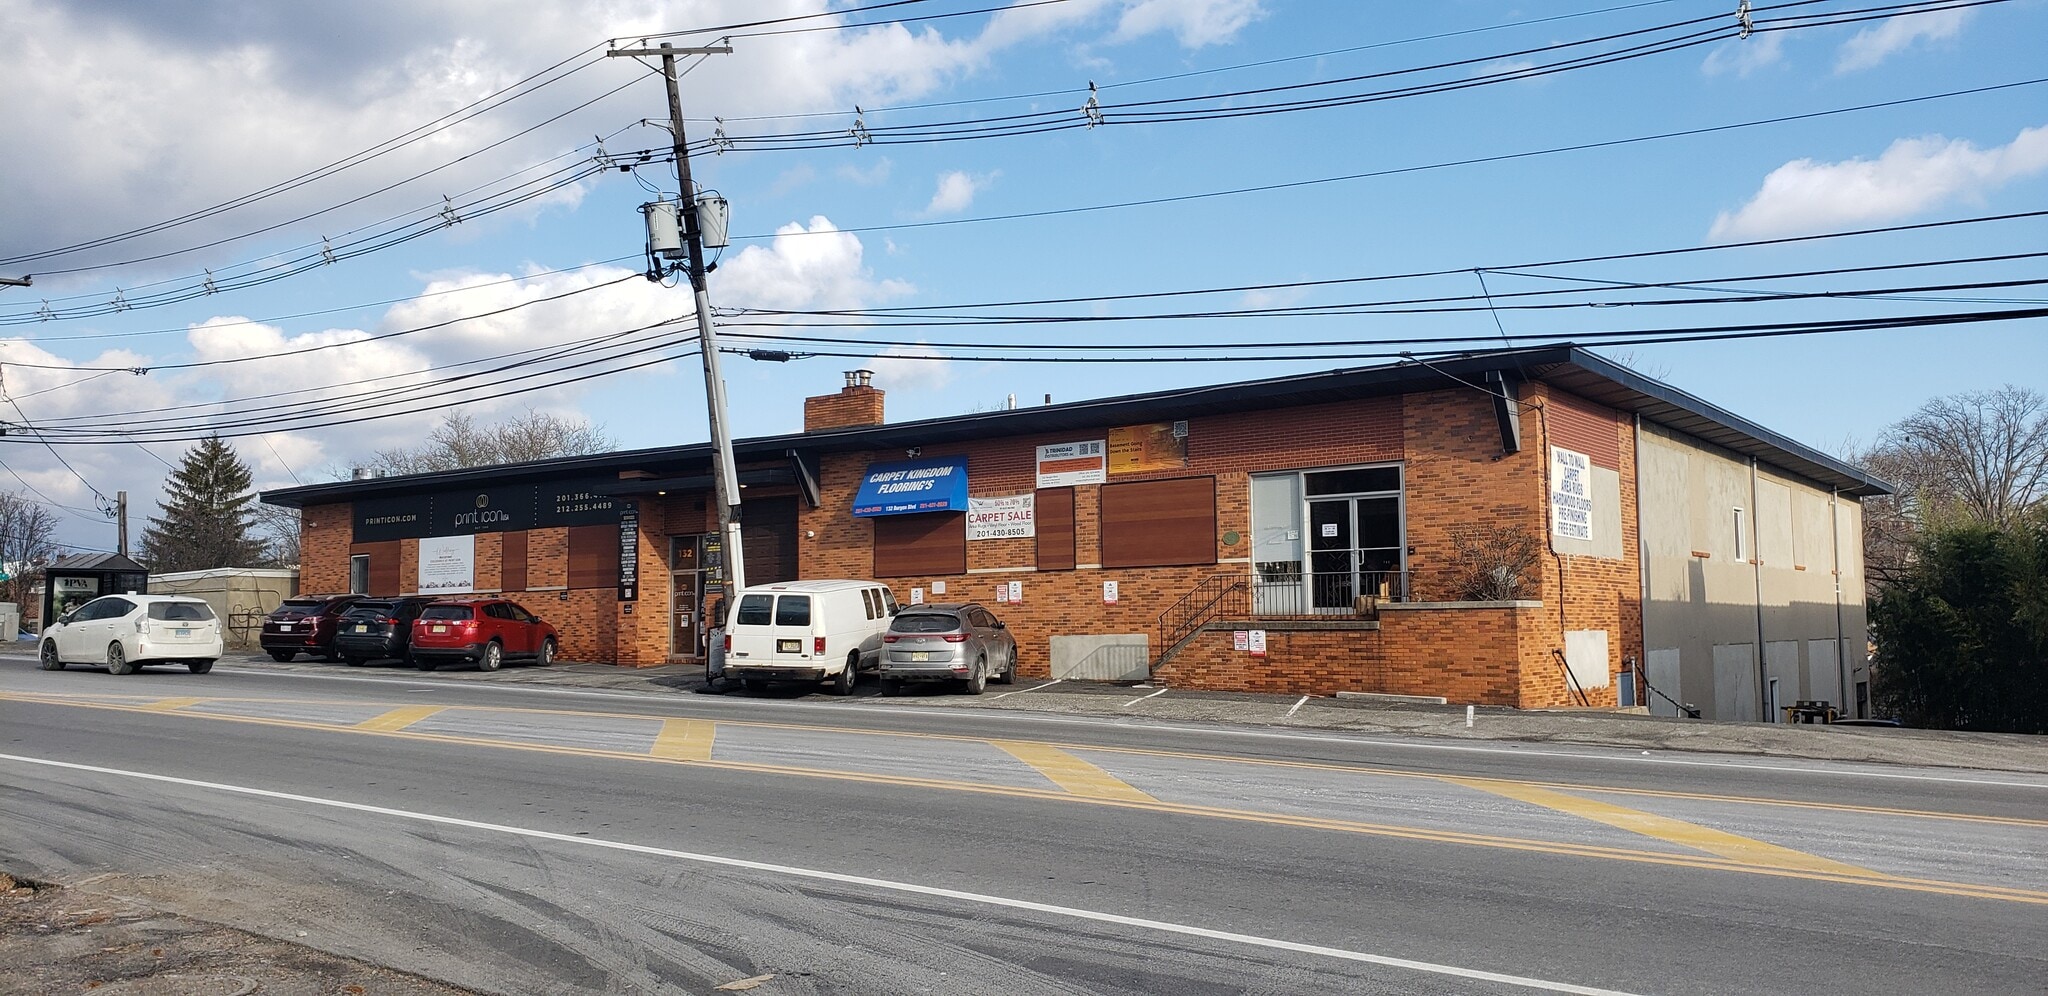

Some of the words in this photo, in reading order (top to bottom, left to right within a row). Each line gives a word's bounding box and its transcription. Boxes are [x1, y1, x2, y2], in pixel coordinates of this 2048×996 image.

[1050, 446, 1073, 454] TRINIDAD
[1556, 450, 1568, 466] WALL
[1568, 453, 1574, 467] TO
[1574, 455, 1585, 470] WALL
[869, 470, 907, 483] CARPET
[907, 466, 954, 479] KINGDOM
[1564, 466, 1579, 482] CARPET
[877, 480, 935, 494] FLOORING'S
[1561, 479, 1572, 493] AREA
[1572, 481, 1583, 496] RUGS
[556, 502, 612, 513] 212.255.4489
[1553, 491, 1576, 509] HARDWOOD
[1576, 496, 1592, 512] FLOORS
[365, 514, 417, 525] PRINTICON.COM
[455, 508, 478, 528] print
[968, 512, 1005, 523] CARPET
[1007, 511, 1031, 521] SALE
[1558, 506, 1587, 524] PRE-FINISHING
[977, 528, 1025, 538] 201-430-8505
[1558, 521, 1569, 536] FREE
[1569, 523, 1588, 539] ESTIMATE
[679, 549, 693, 558] 132
